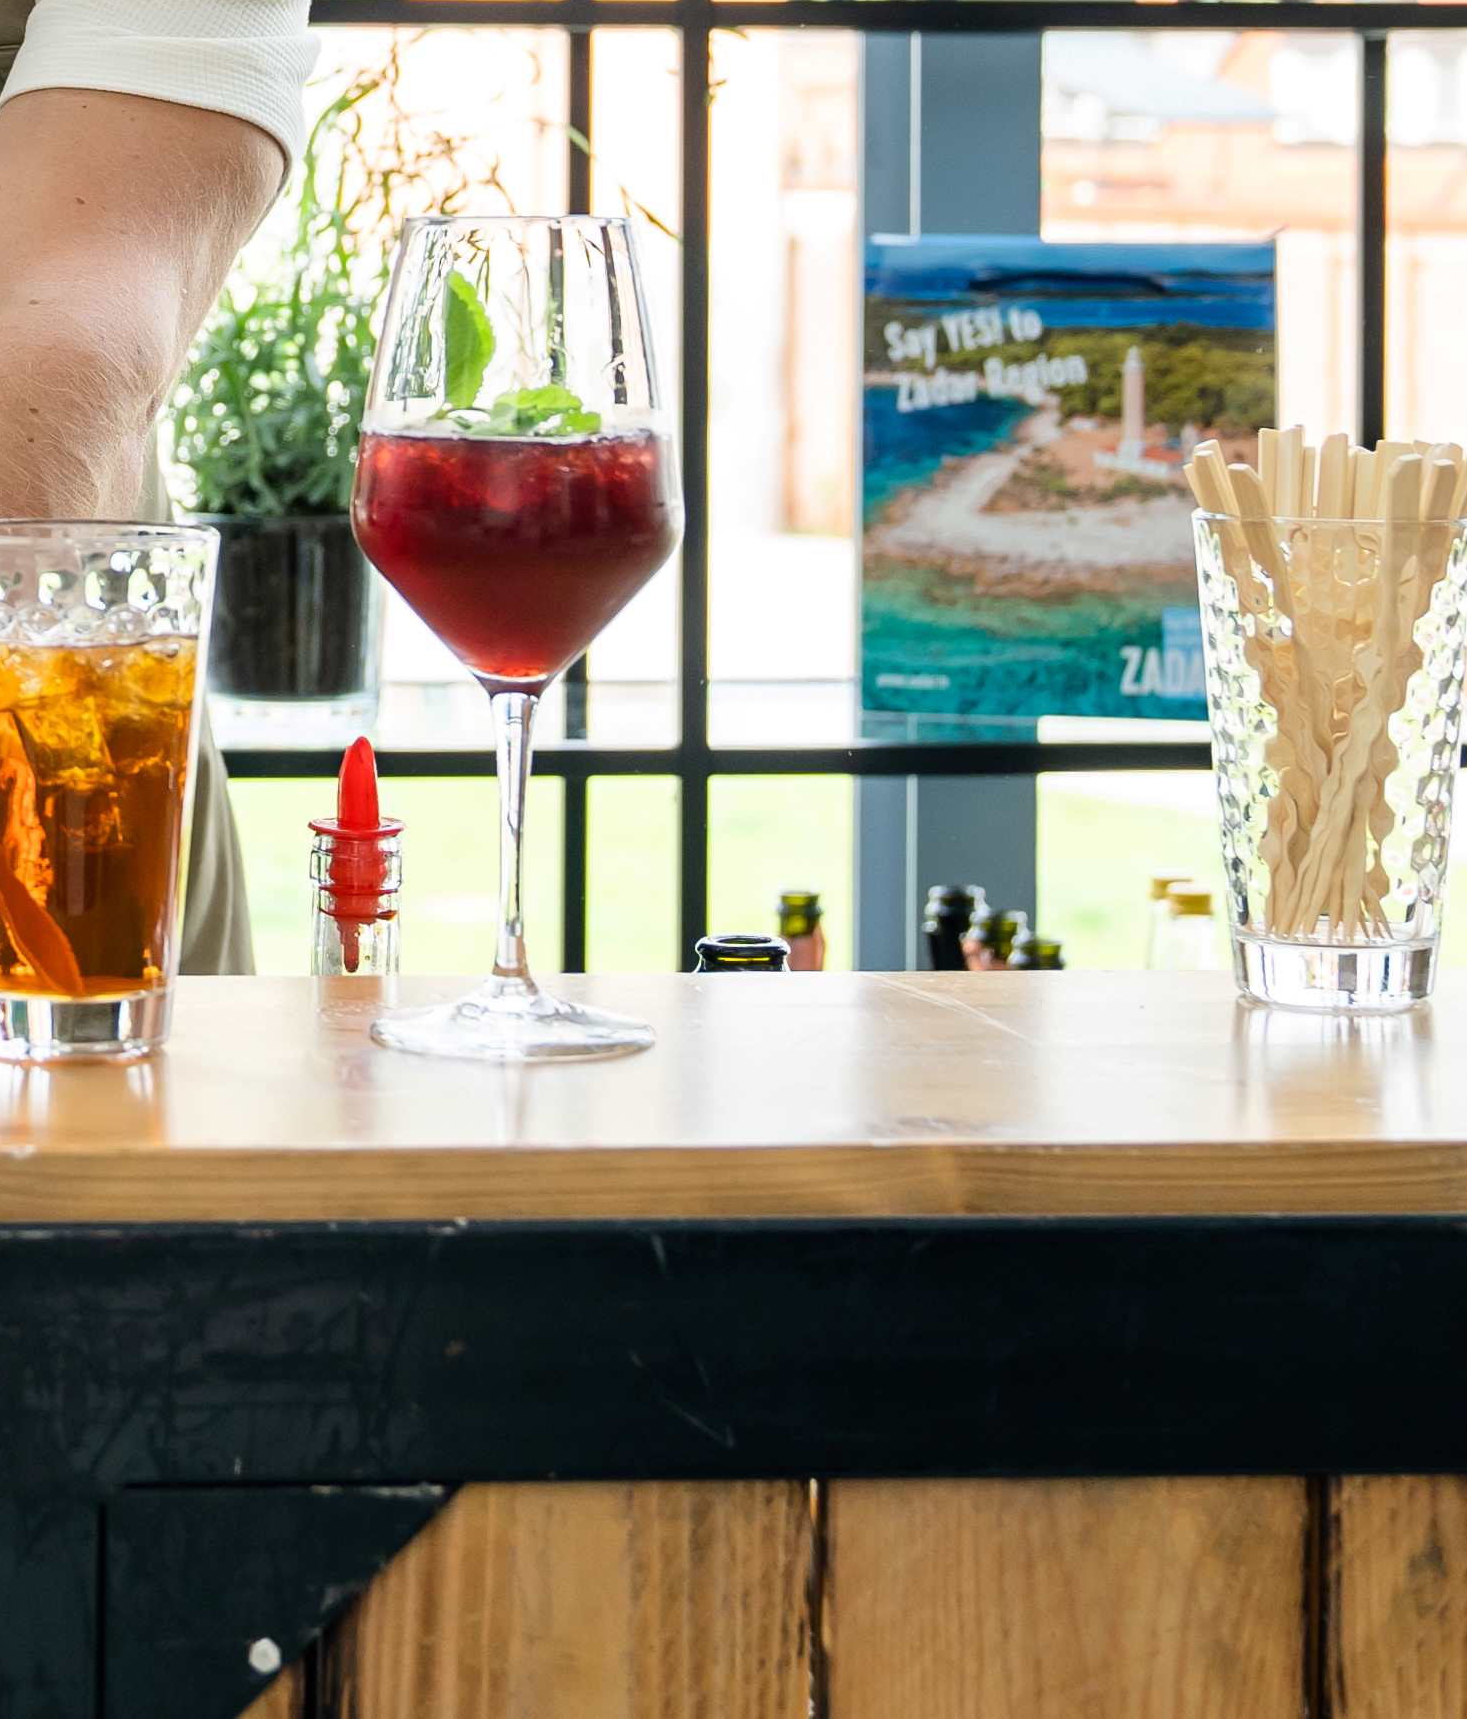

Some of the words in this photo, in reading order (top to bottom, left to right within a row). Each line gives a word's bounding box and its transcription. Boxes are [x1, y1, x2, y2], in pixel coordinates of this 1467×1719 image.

[882, 320, 938, 371] Say
[939, 305, 1004, 353] YES!
[1006, 305, 1043, 342] to
[895, 365, 978, 414] Zadar
[982, 352, 1088, 407] Region
[1119, 644, 1210, 698] ZADA
